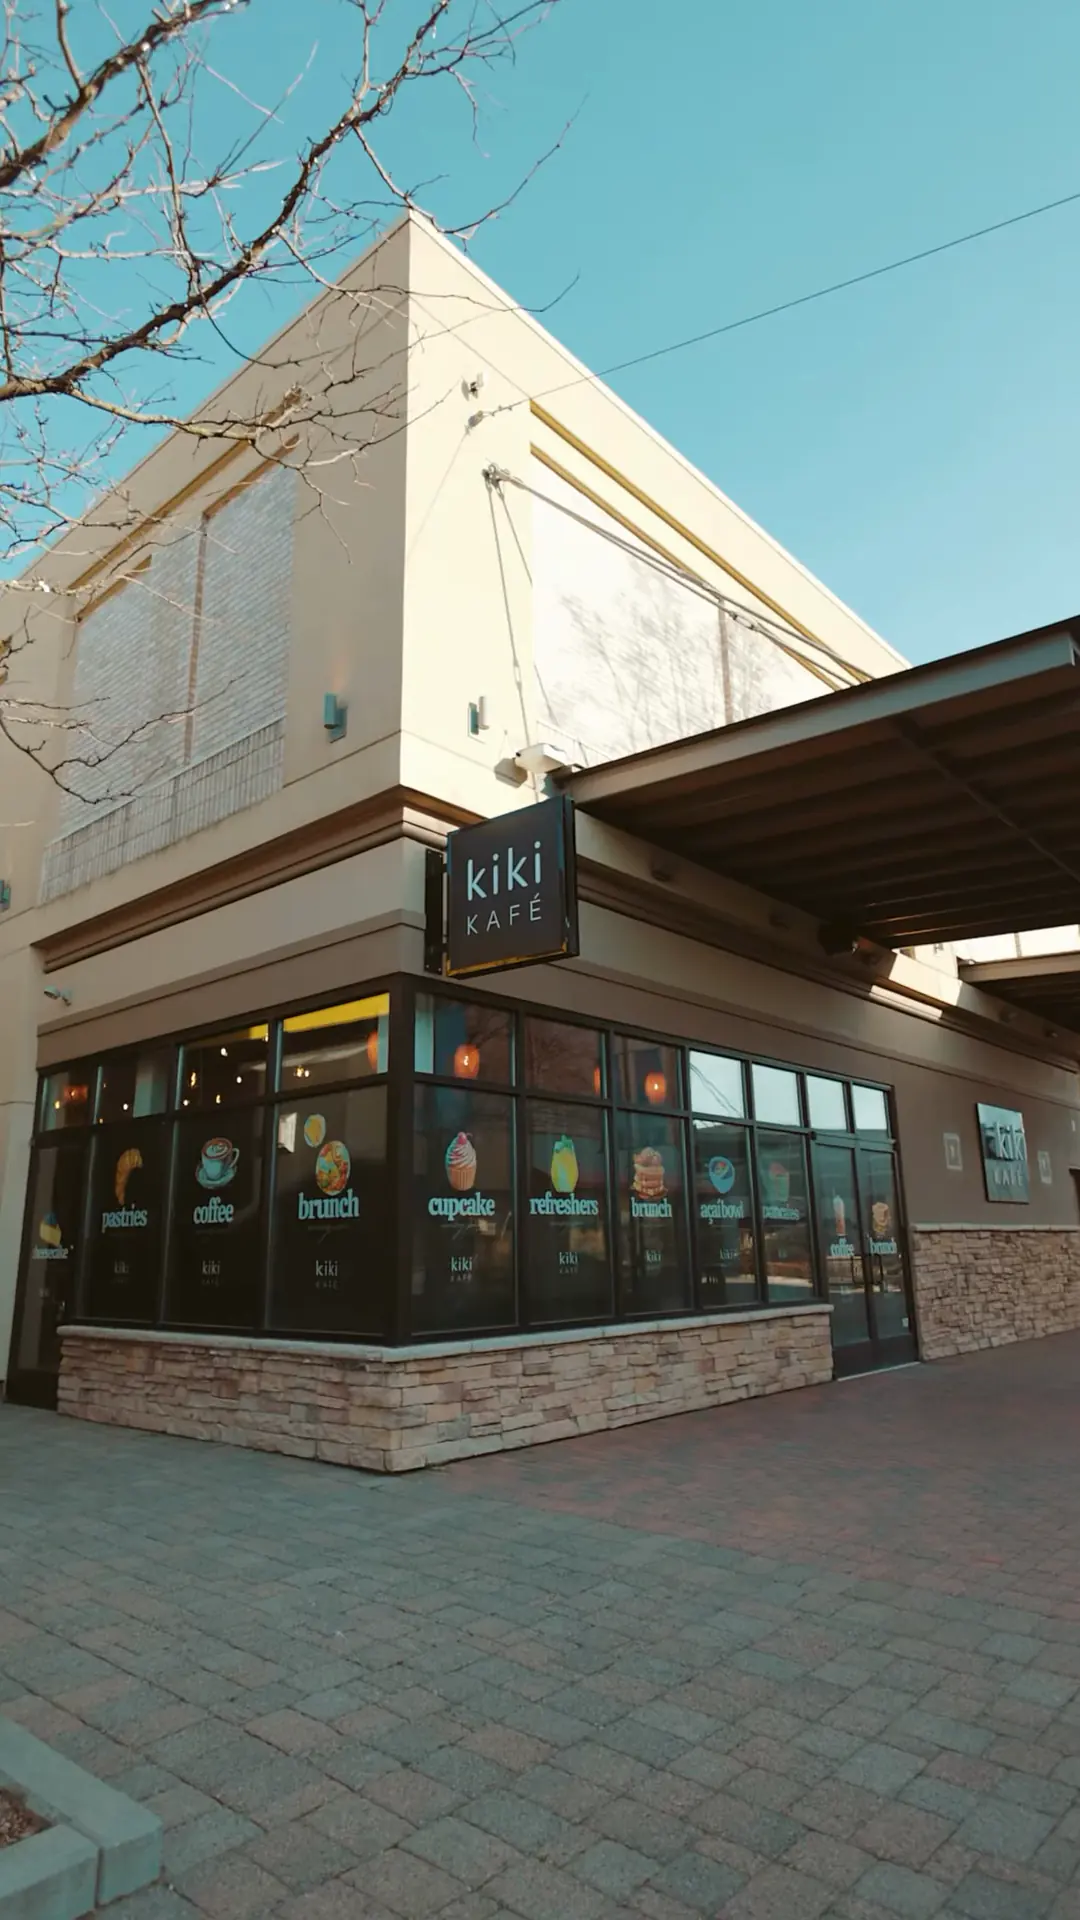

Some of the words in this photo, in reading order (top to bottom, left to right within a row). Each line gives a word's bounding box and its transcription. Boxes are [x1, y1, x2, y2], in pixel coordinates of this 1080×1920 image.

[467, 841, 541, 901] kiki
[467, 893, 542, 936] KAFÉ
[193, 1196, 234, 1225] coffee
[298, 1188, 360, 1220] brunch
[428, 1192, 496, 1221] cupcake
[529, 1191, 599, 1216] refreshers
[631, 1197, 672, 1218] brunch
[101, 1203, 148, 1234] pastries
[202, 1260, 221, 1275] kiki
[315, 1260, 338, 1276] kiki
[451, 1256, 473, 1271] kiki
[559, 1252, 578, 1265] kiki
